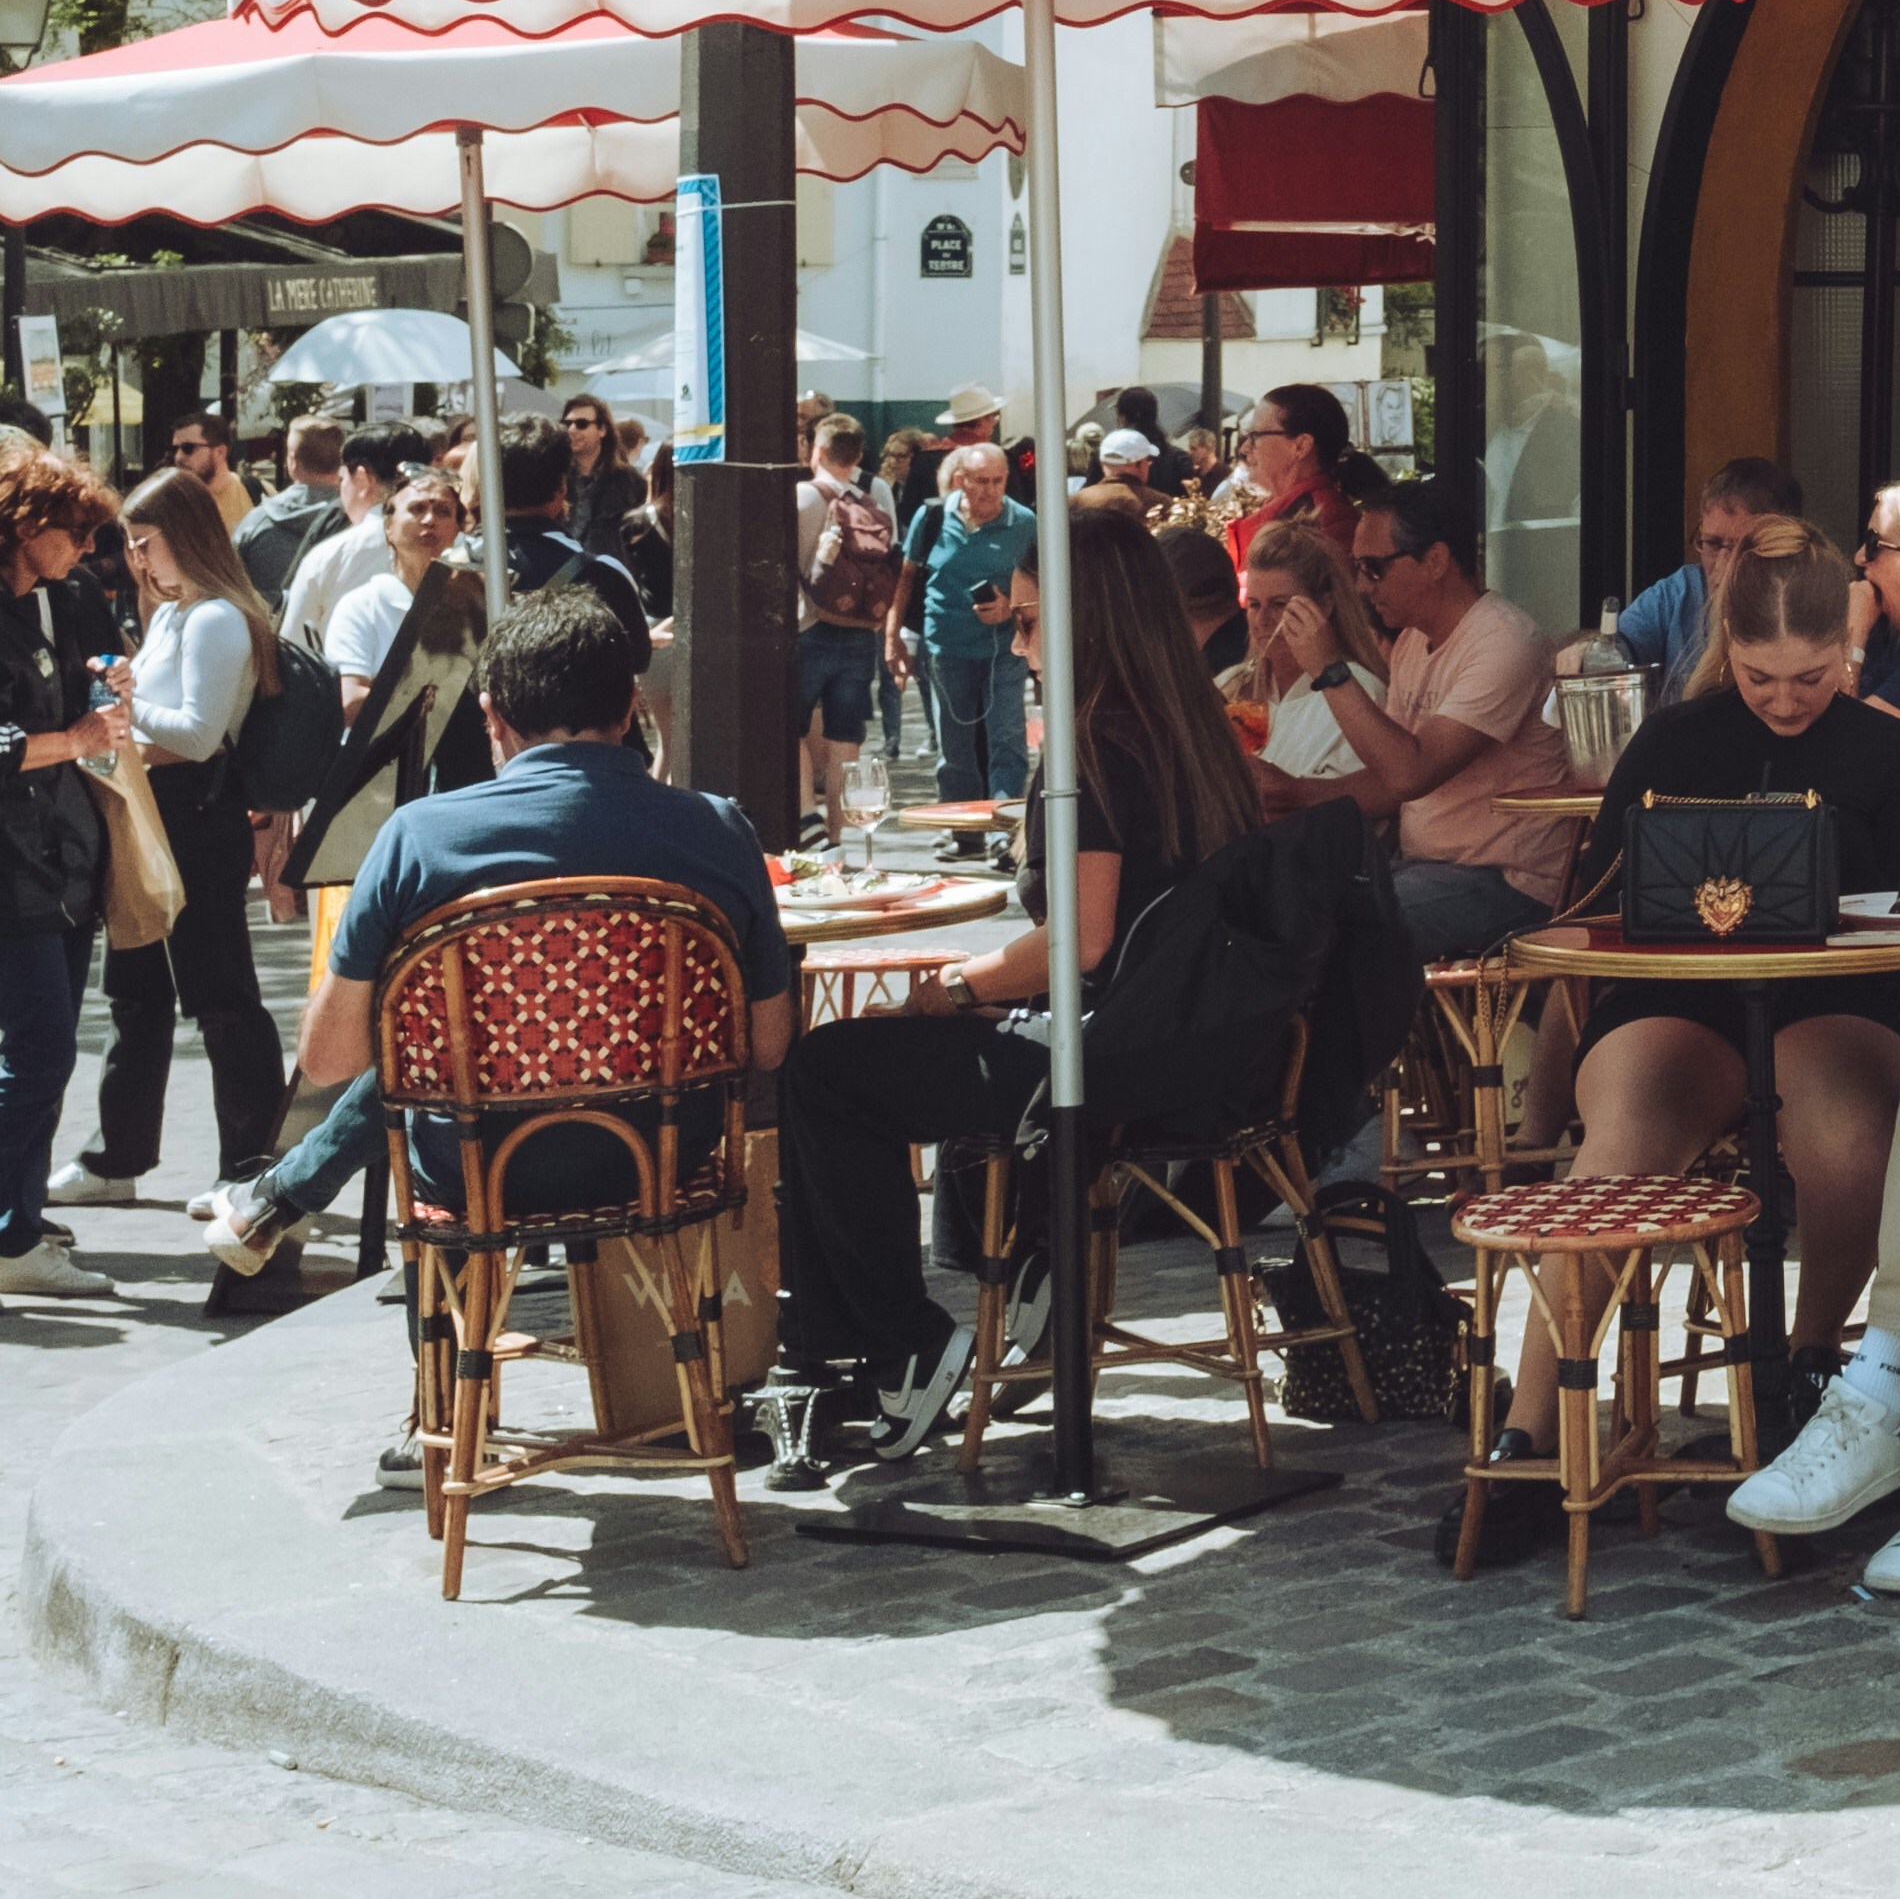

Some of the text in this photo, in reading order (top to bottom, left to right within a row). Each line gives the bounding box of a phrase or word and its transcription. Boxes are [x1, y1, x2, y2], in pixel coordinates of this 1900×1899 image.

[930, 239, 962, 251] PLACE
[267, 280, 285, 311] LA
[318, 275, 379, 308] CATHERINE
